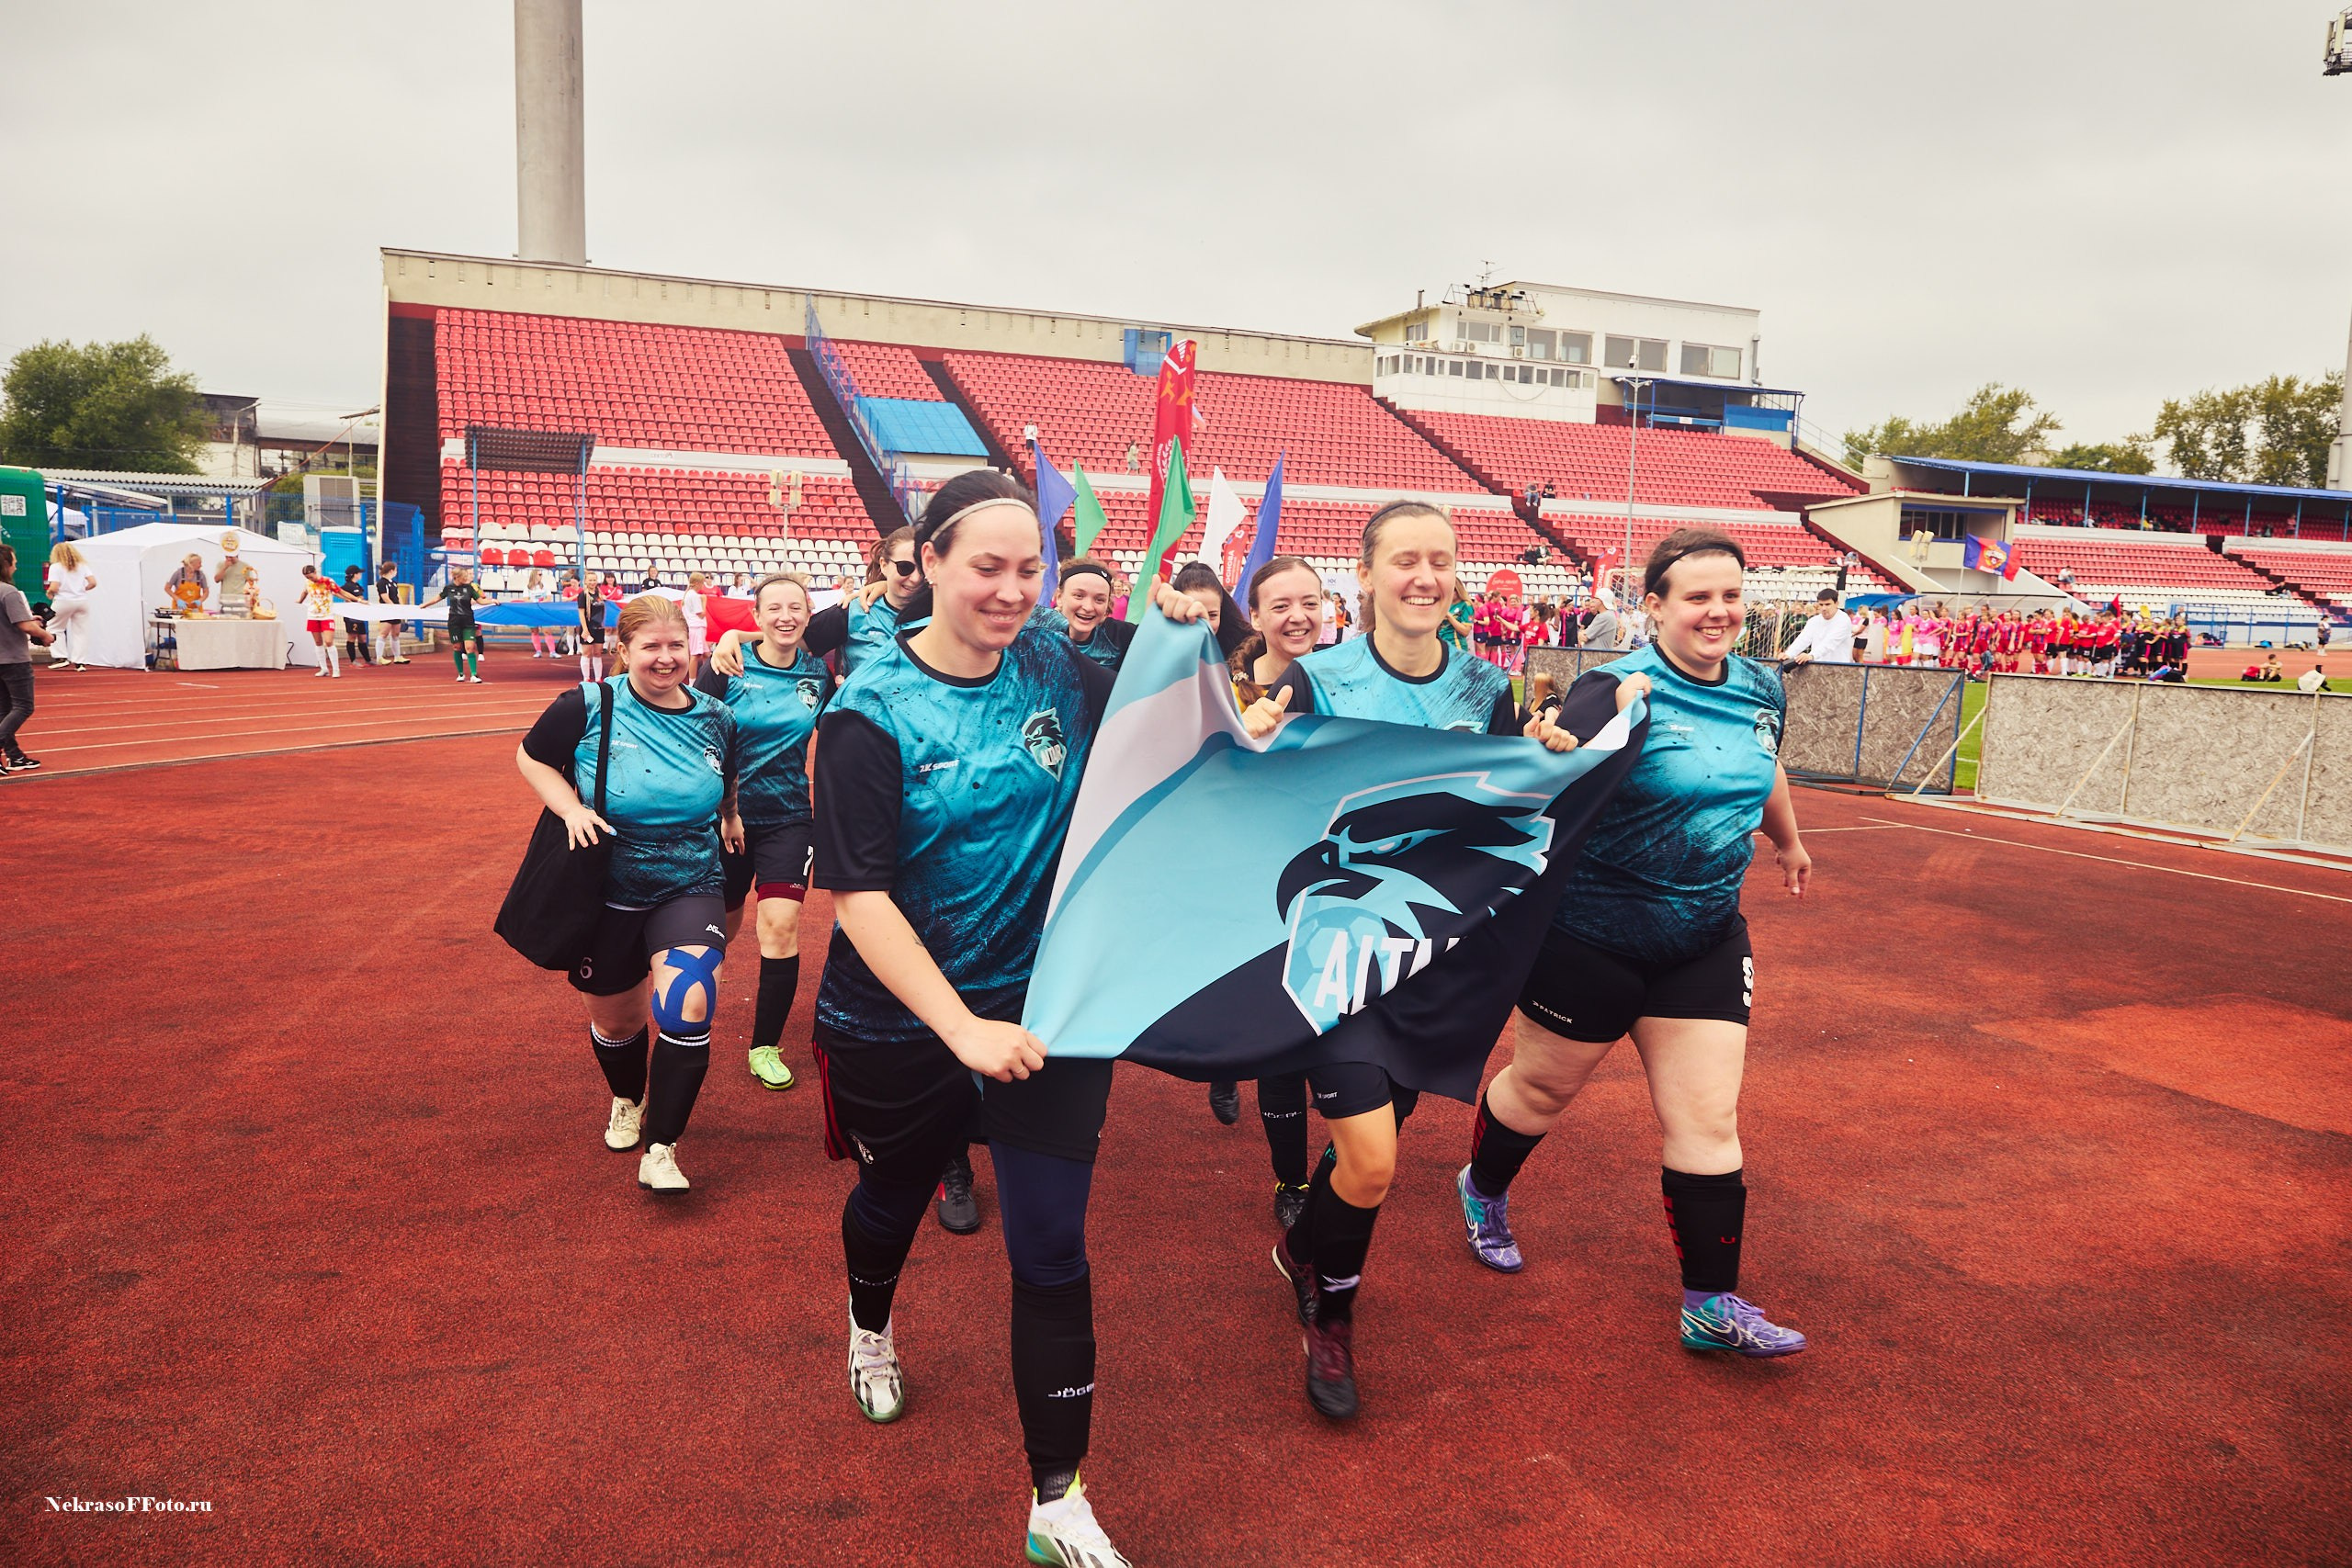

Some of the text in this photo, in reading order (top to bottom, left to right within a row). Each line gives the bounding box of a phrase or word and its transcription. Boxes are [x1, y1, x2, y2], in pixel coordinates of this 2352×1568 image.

[1596, 563, 1606, 589] СНОВА
[579, 956, 594, 980] 6
[1539, 1005, 1573, 1024] PATRICK
